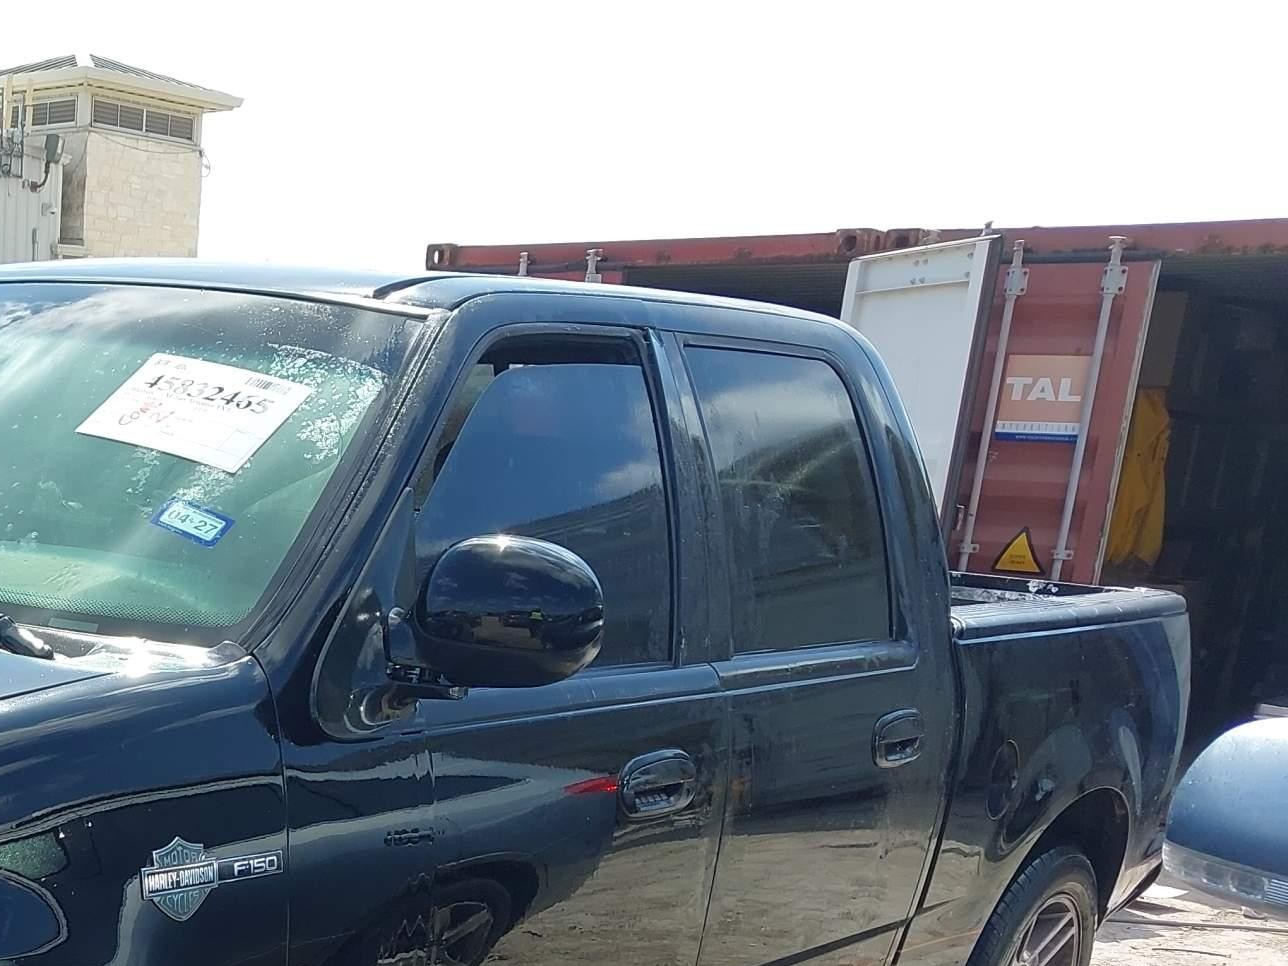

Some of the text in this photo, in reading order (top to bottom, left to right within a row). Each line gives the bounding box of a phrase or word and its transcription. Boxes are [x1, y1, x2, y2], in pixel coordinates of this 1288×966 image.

[144, 374, 276, 415] 45832465
[1006, 377, 1082, 402] TAL
[164, 846, 197, 867] MOTOR
[145, 865, 214, 892] HARLEY-DAVIDSON
